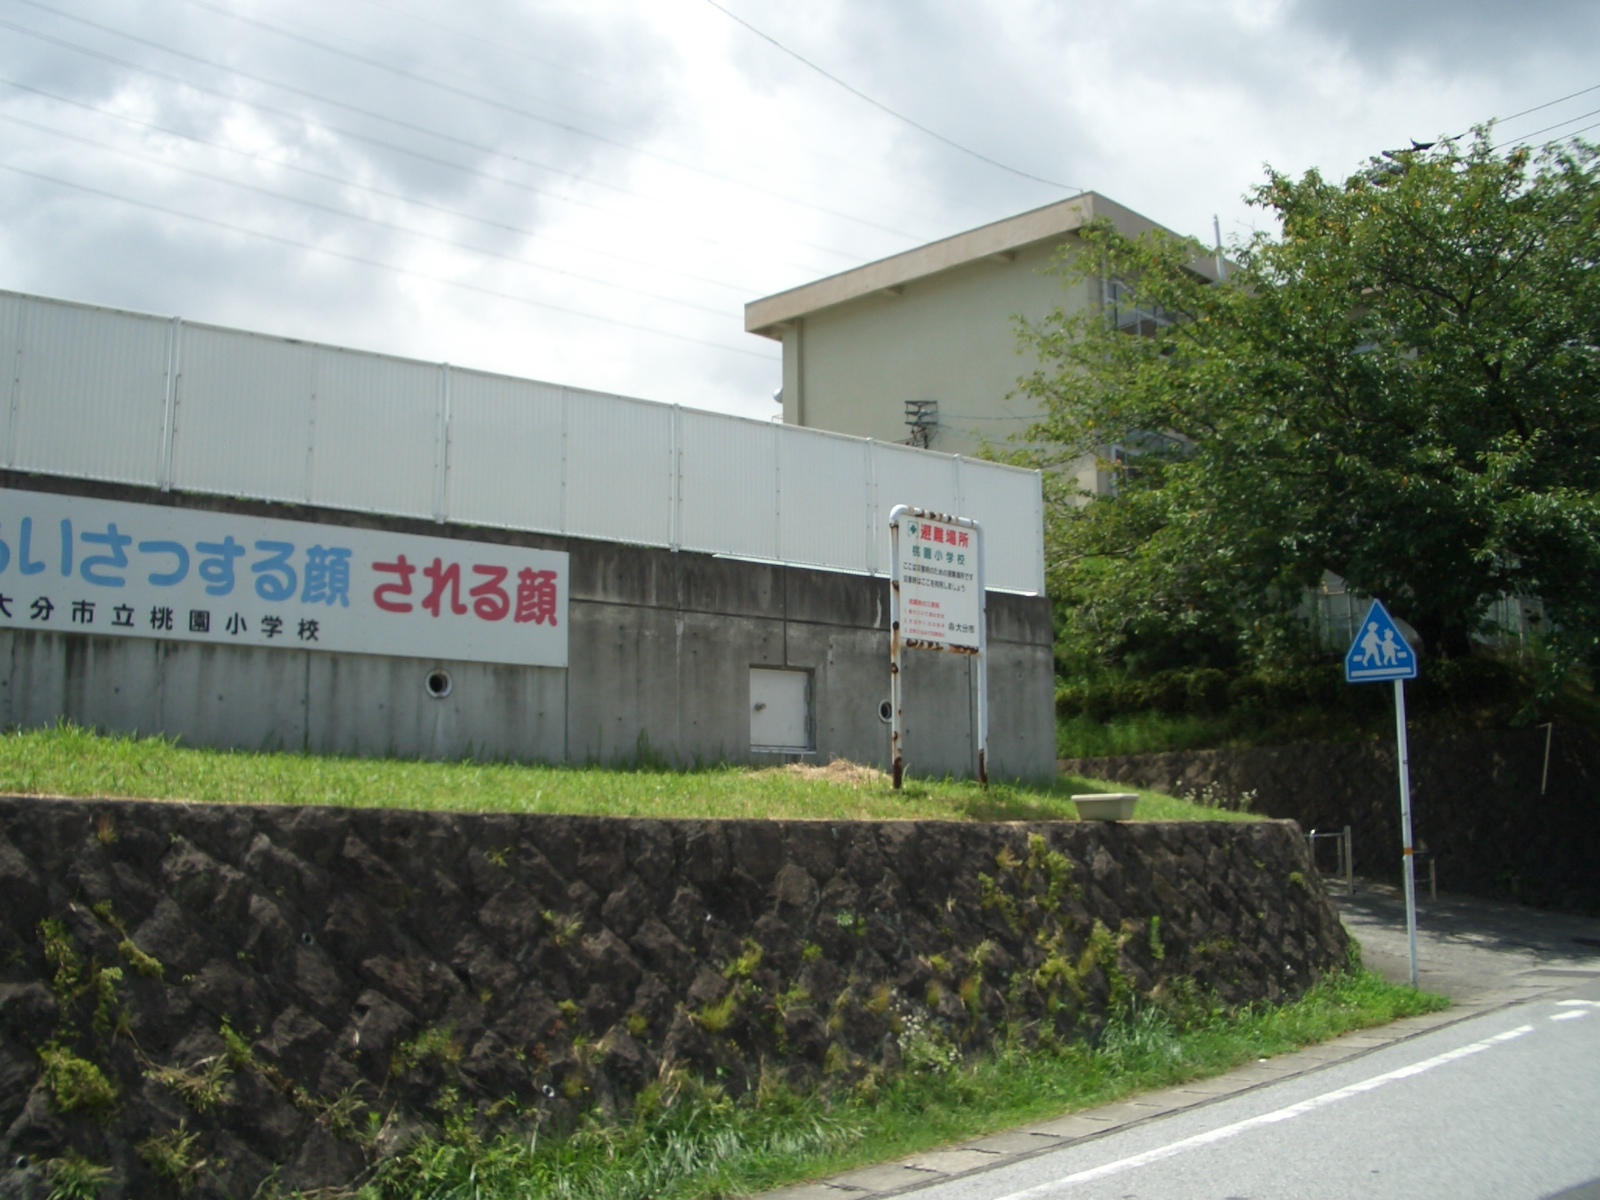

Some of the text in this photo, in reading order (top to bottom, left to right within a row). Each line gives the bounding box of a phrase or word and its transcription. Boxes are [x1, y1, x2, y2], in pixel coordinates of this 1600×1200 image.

[920, 523, 969, 549] 避難場所
[912, 545, 966, 566] 桃園小学校
[0, 516, 558, 627] いさつする顔 される顔
